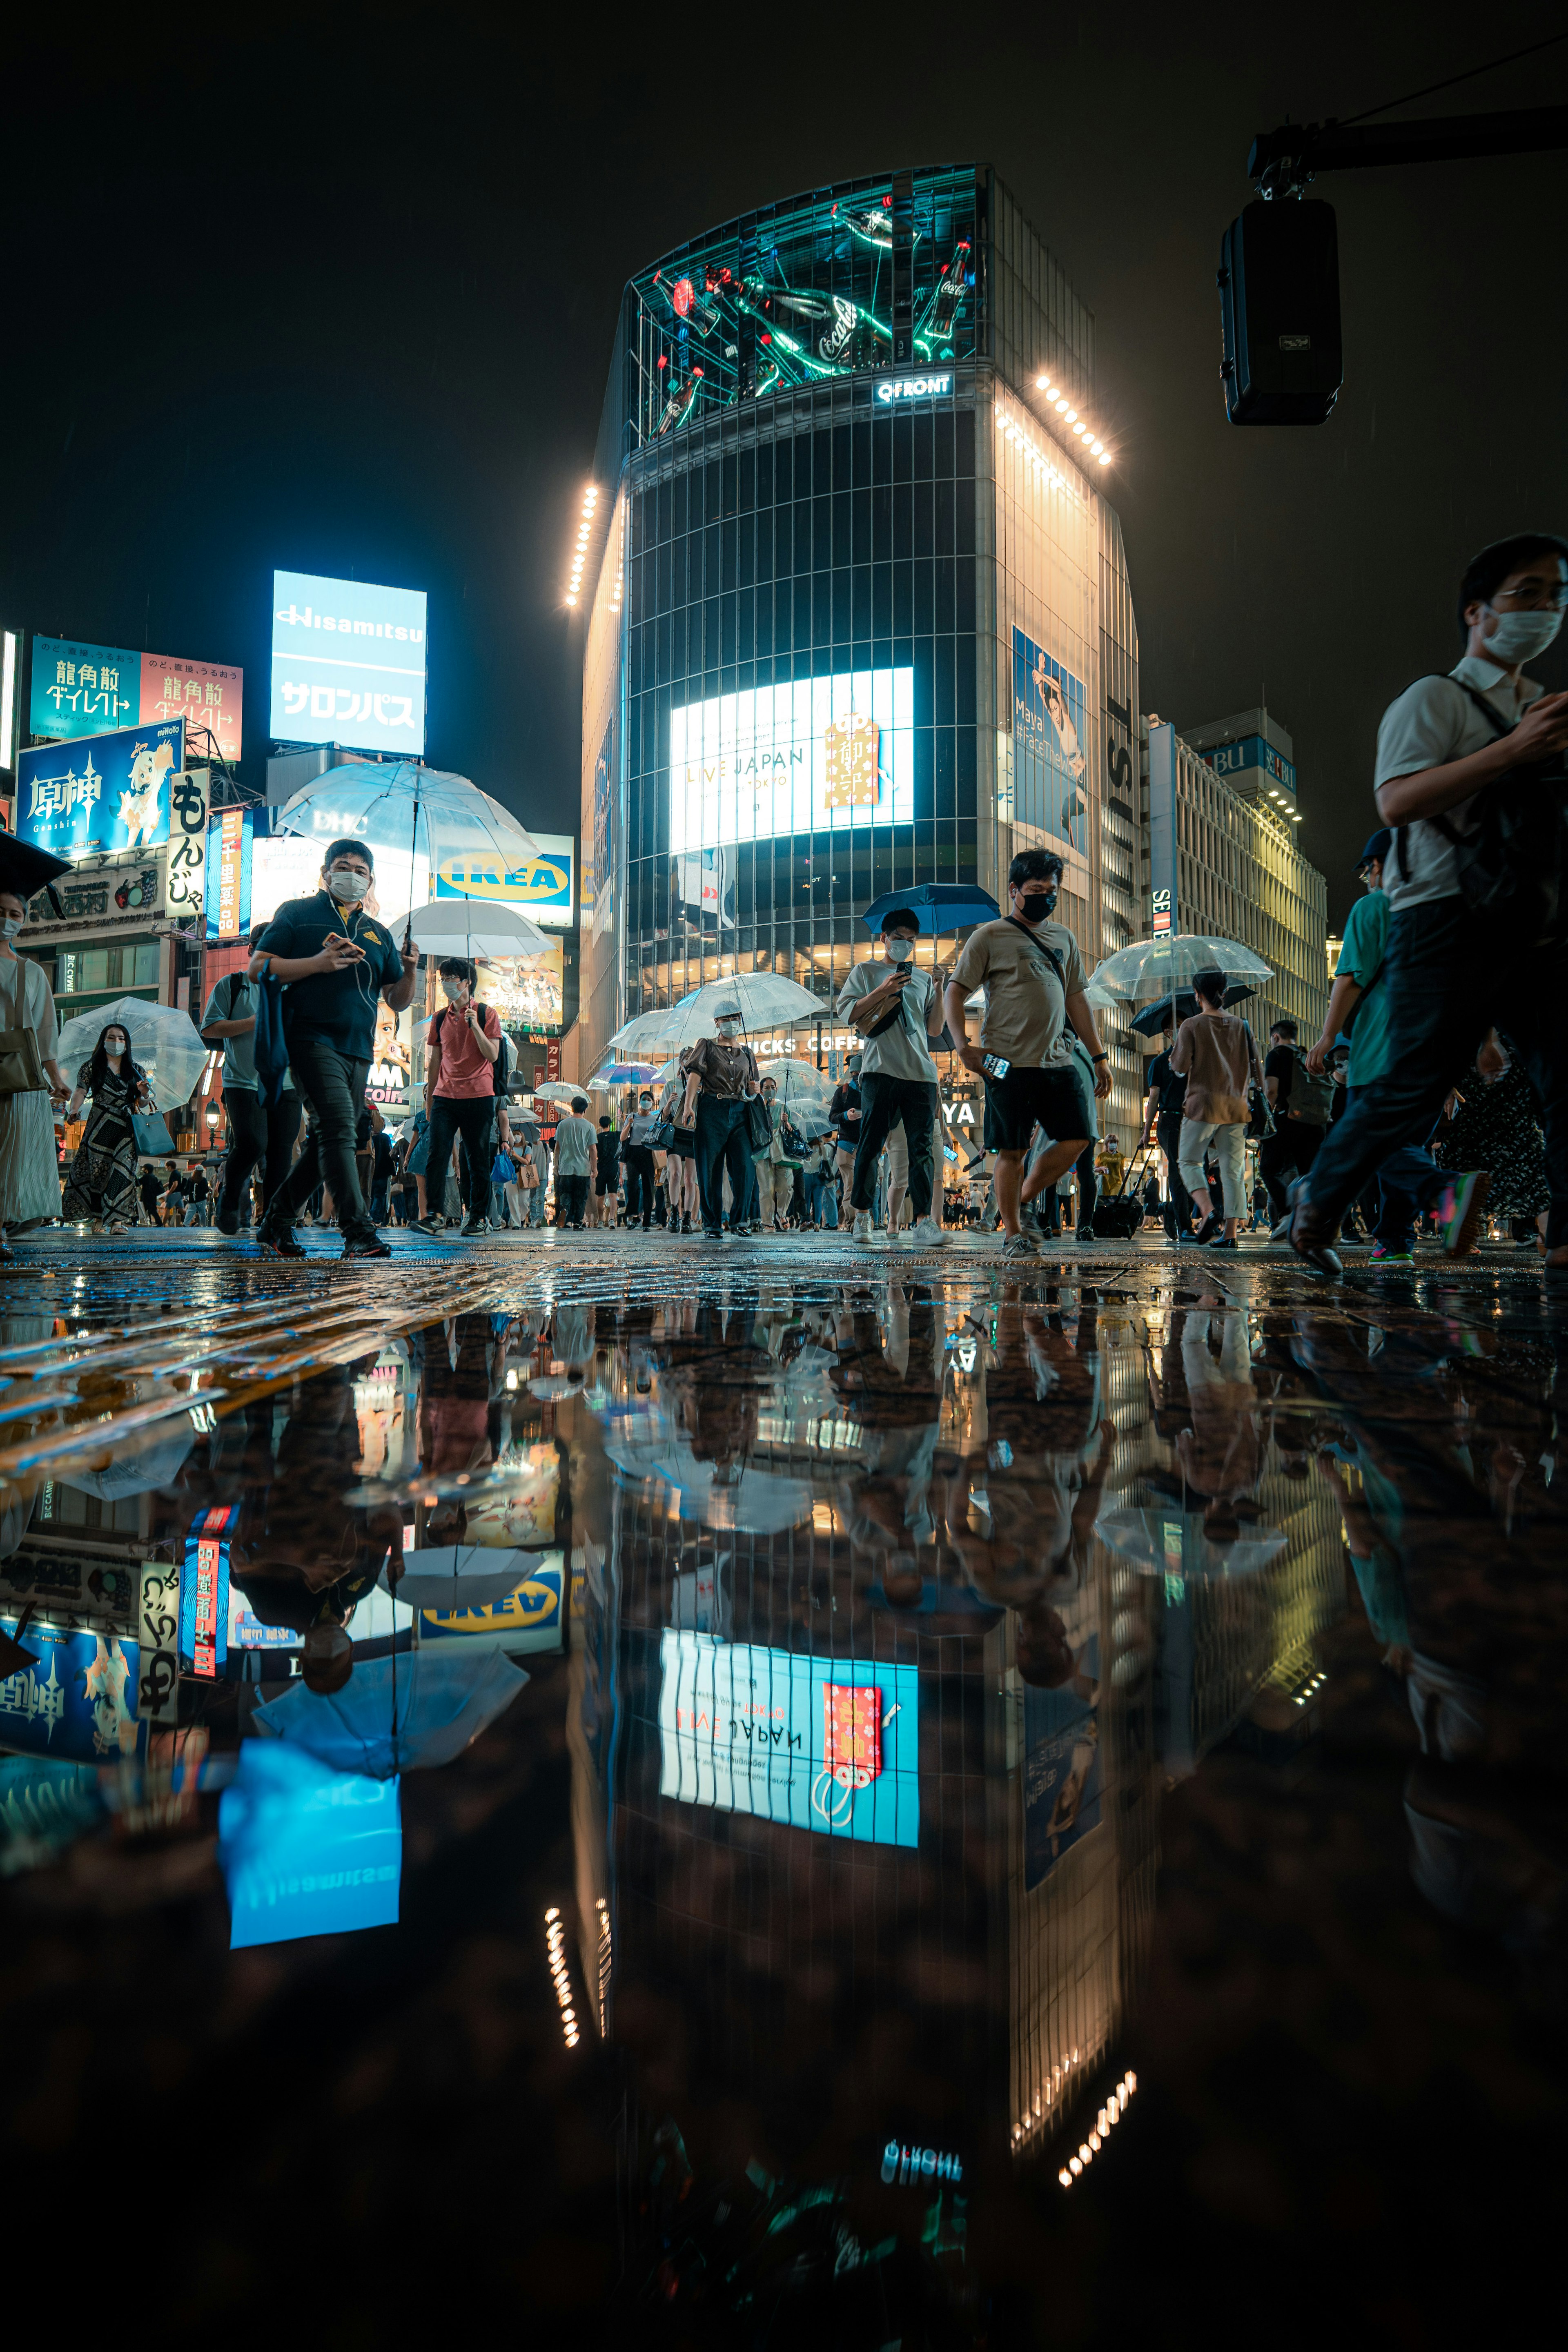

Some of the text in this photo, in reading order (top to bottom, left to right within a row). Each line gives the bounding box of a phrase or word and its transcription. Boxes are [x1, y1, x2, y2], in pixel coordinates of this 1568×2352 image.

[878, 377, 949, 403] QFRONT
[276, 604, 423, 643] Hisamitsu
[56, 660, 119, 691] 龍角散
[163, 676, 223, 706] 龍角散
[46, 685, 130, 717] ダイレクト
[281, 681, 415, 729] サロンパス
[1016, 696, 1042, 732] Maya
[56, 713, 88, 722] スティック
[220, 744, 237, 752] 生薬
[687, 748, 803, 783] LIVE JAPAN
[27, 750, 103, 834] 原神
[747, 776, 787, 791] TOKYO
[33, 819, 77, 833] Genshin
[169, 775, 206, 911] もんじゃ
[218, 816, 237, 931] 三千里薬品
[452, 862, 559, 889] IKEA
[739, 1038, 796, 1055] UCKS
[548, 1045, 558, 1082] カラオ
